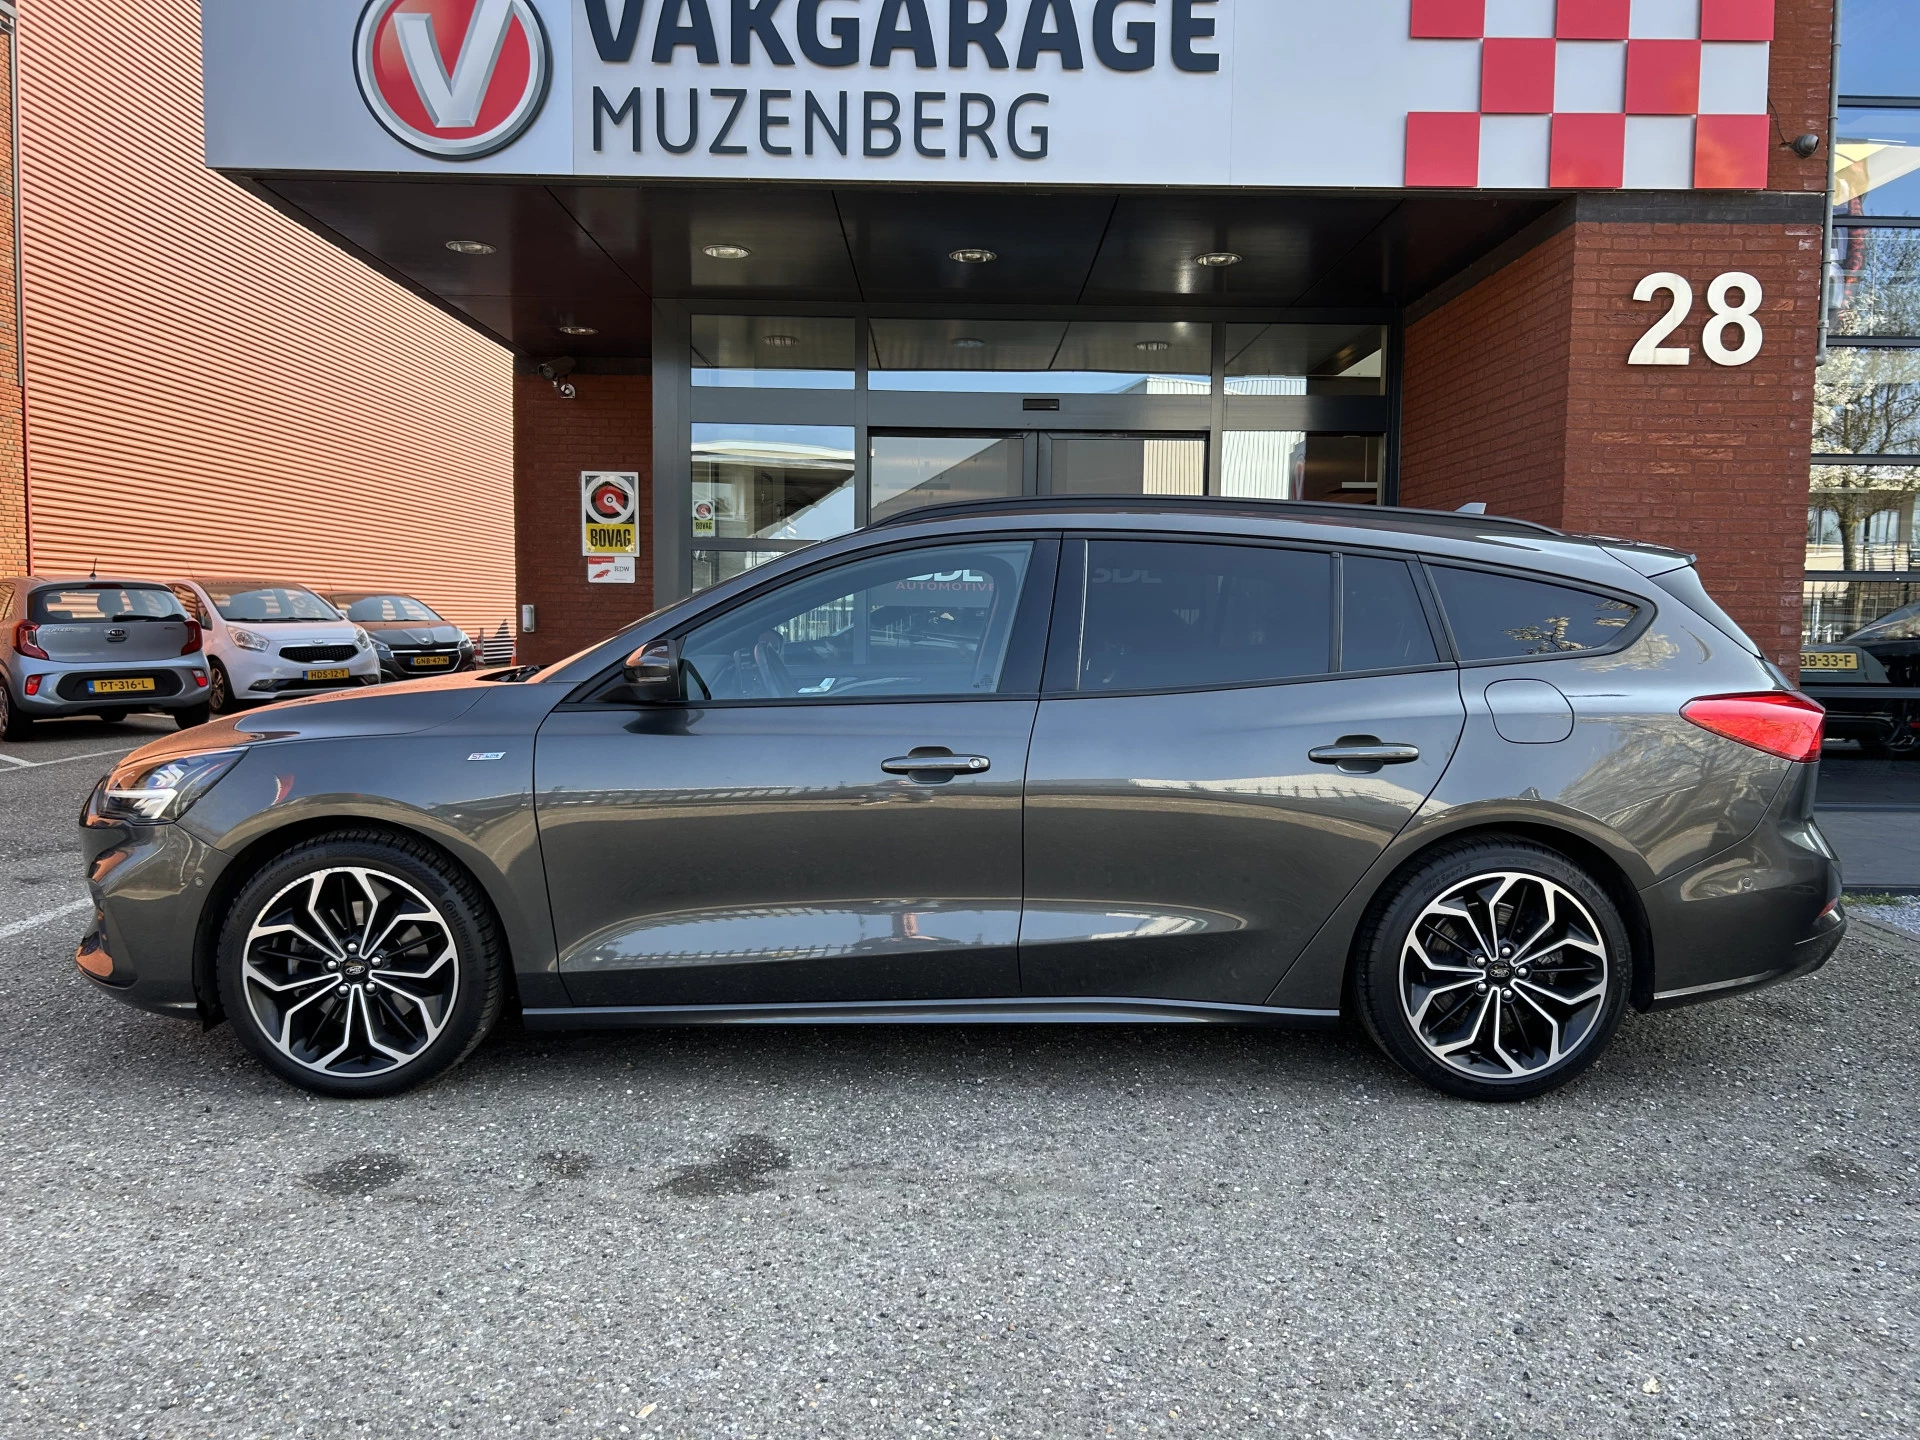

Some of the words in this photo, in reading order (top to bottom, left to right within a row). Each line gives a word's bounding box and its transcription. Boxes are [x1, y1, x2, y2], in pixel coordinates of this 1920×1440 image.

[584, 0, 1220, 72] VAKGARAGE
[592, 86, 1049, 159] MUZENBERG
[1627, 271, 1763, 366] 28
[695, 521, 713, 530] BOVAG
[590, 529, 631, 547] BOVAG
[895, 581, 994, 592] AUTOMOTIVE
[311, 670, 346, 679] HDS-12-T
[100, 680, 148, 691] PT-316-L
